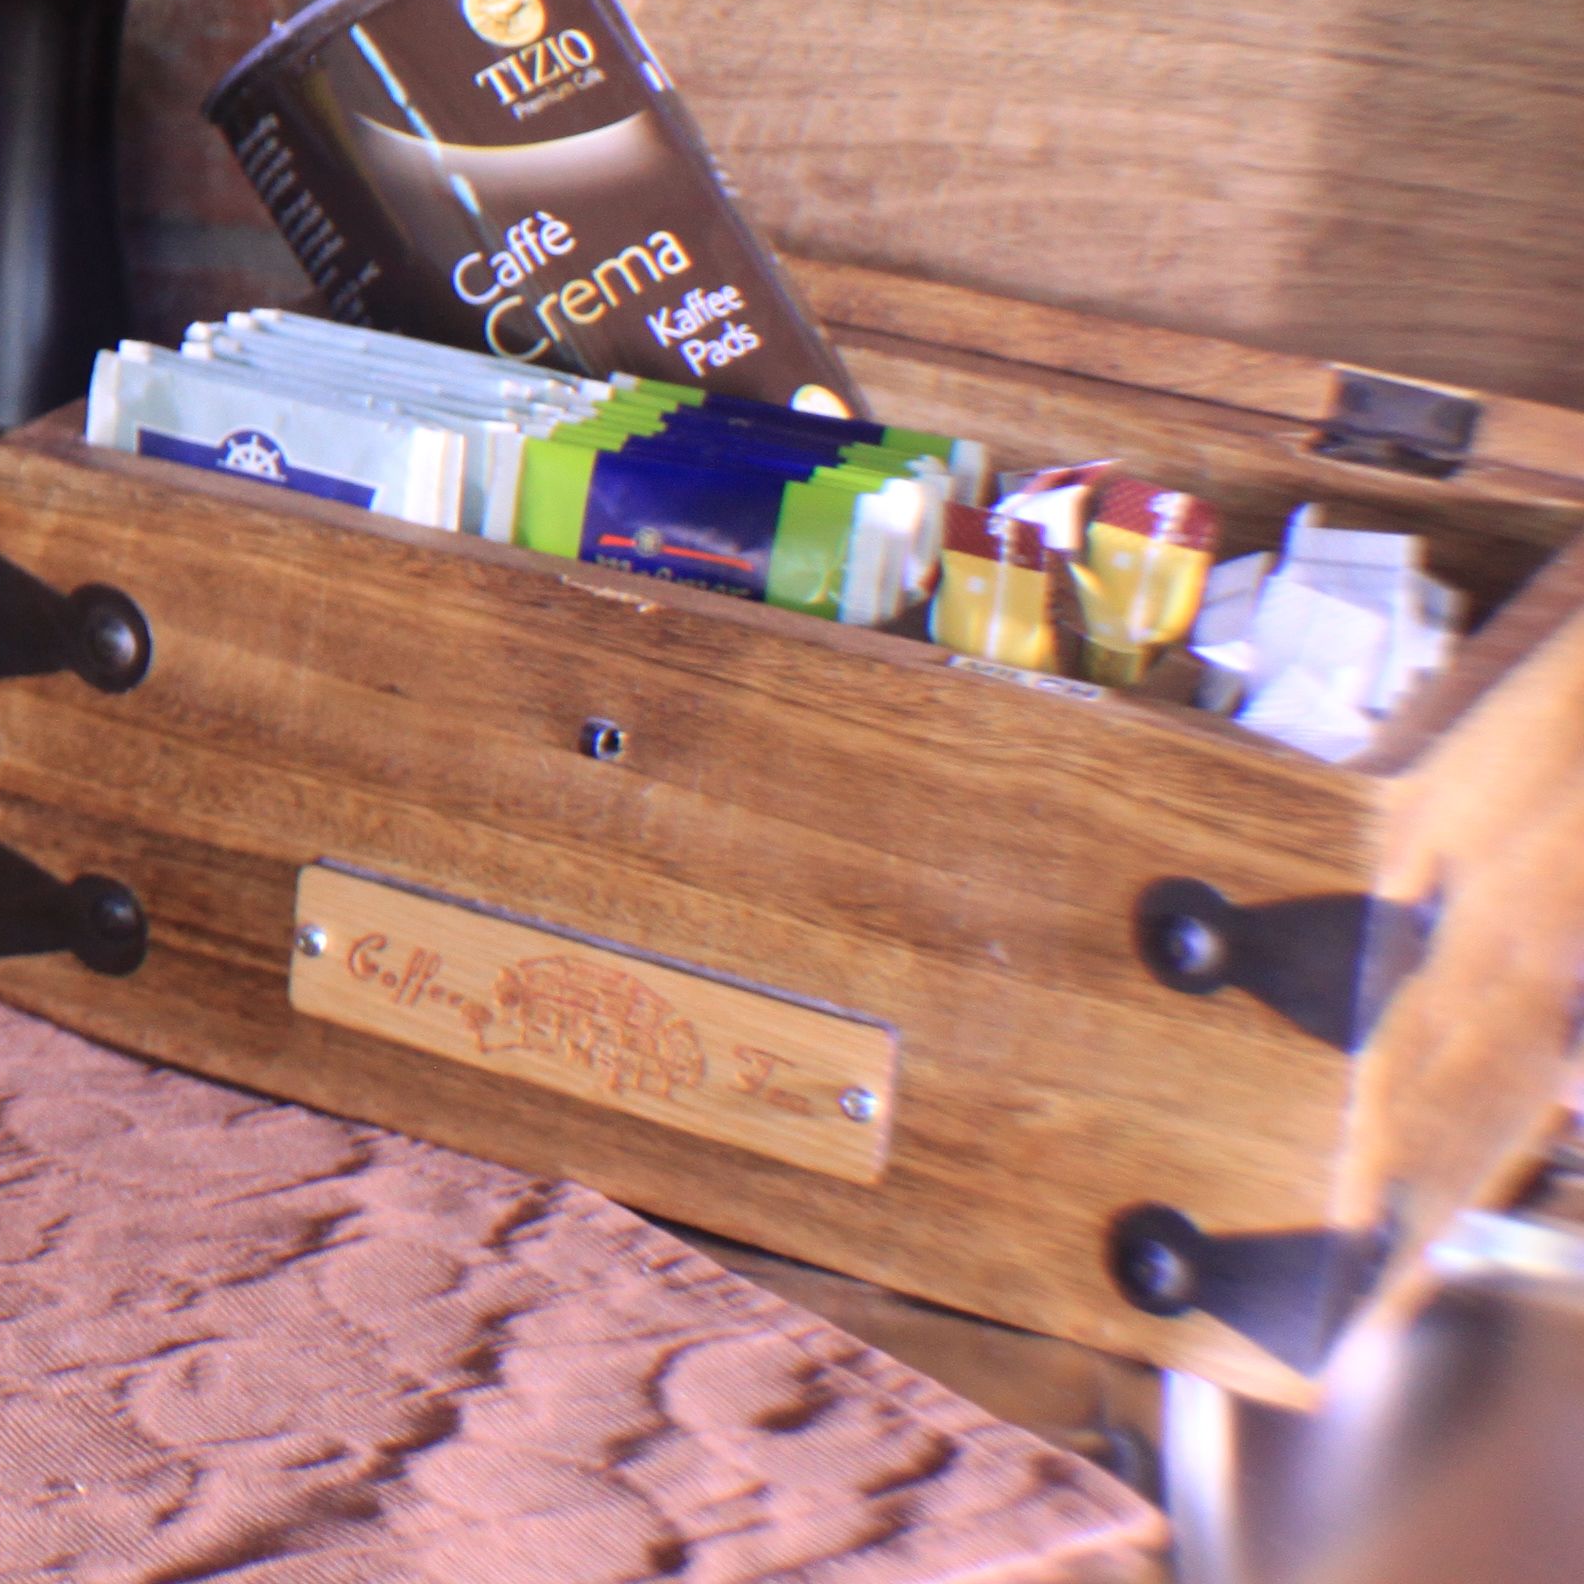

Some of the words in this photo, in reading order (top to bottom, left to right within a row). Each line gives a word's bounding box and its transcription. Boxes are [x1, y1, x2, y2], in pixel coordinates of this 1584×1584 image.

[472, 28, 597, 106] TIZIO
[452, 211, 578, 306] Caffè
[484, 230, 692, 361] Crema
[647, 285, 745, 348] Kaffee
[680, 320, 762, 377] Pads
[347, 932, 464, 1007] Coffee
